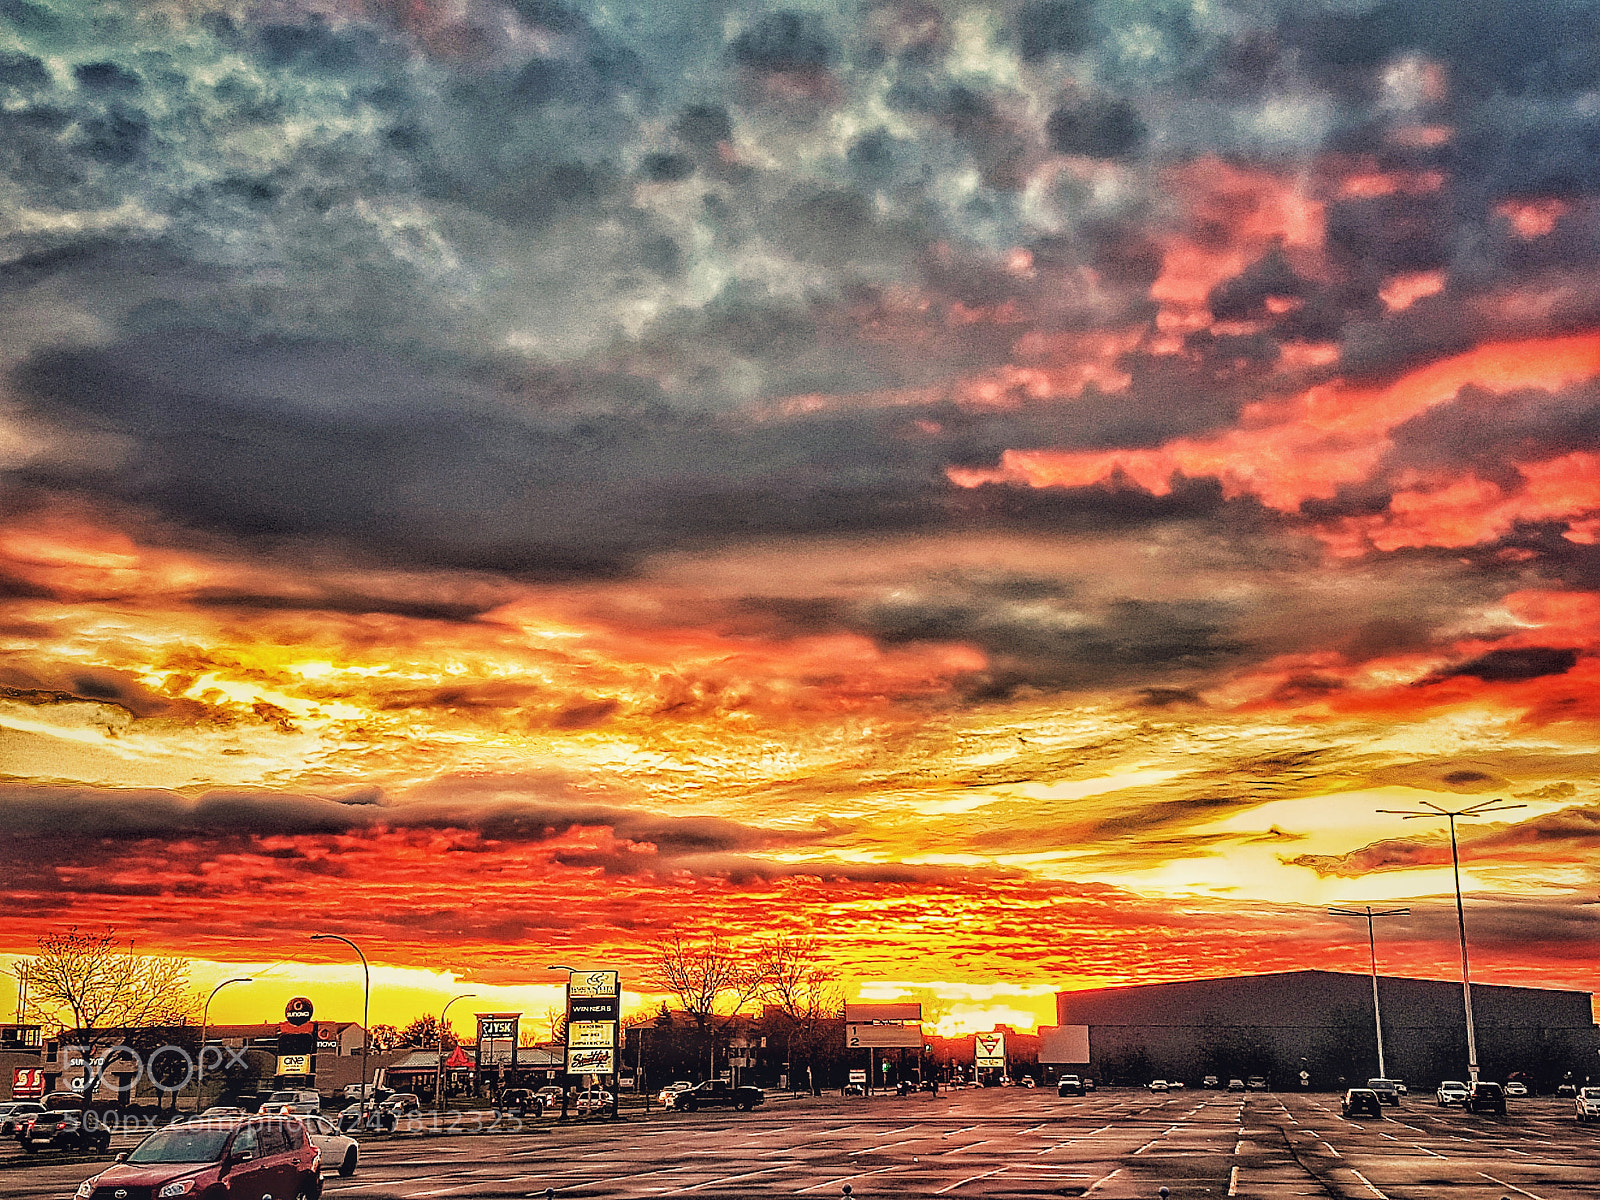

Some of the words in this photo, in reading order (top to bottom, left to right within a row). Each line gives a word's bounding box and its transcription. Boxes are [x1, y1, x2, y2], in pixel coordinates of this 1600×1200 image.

[488, 1022, 512, 1033] JYSK
[852, 1026, 857, 1035] 1
[850, 1037, 860, 1046] 2
